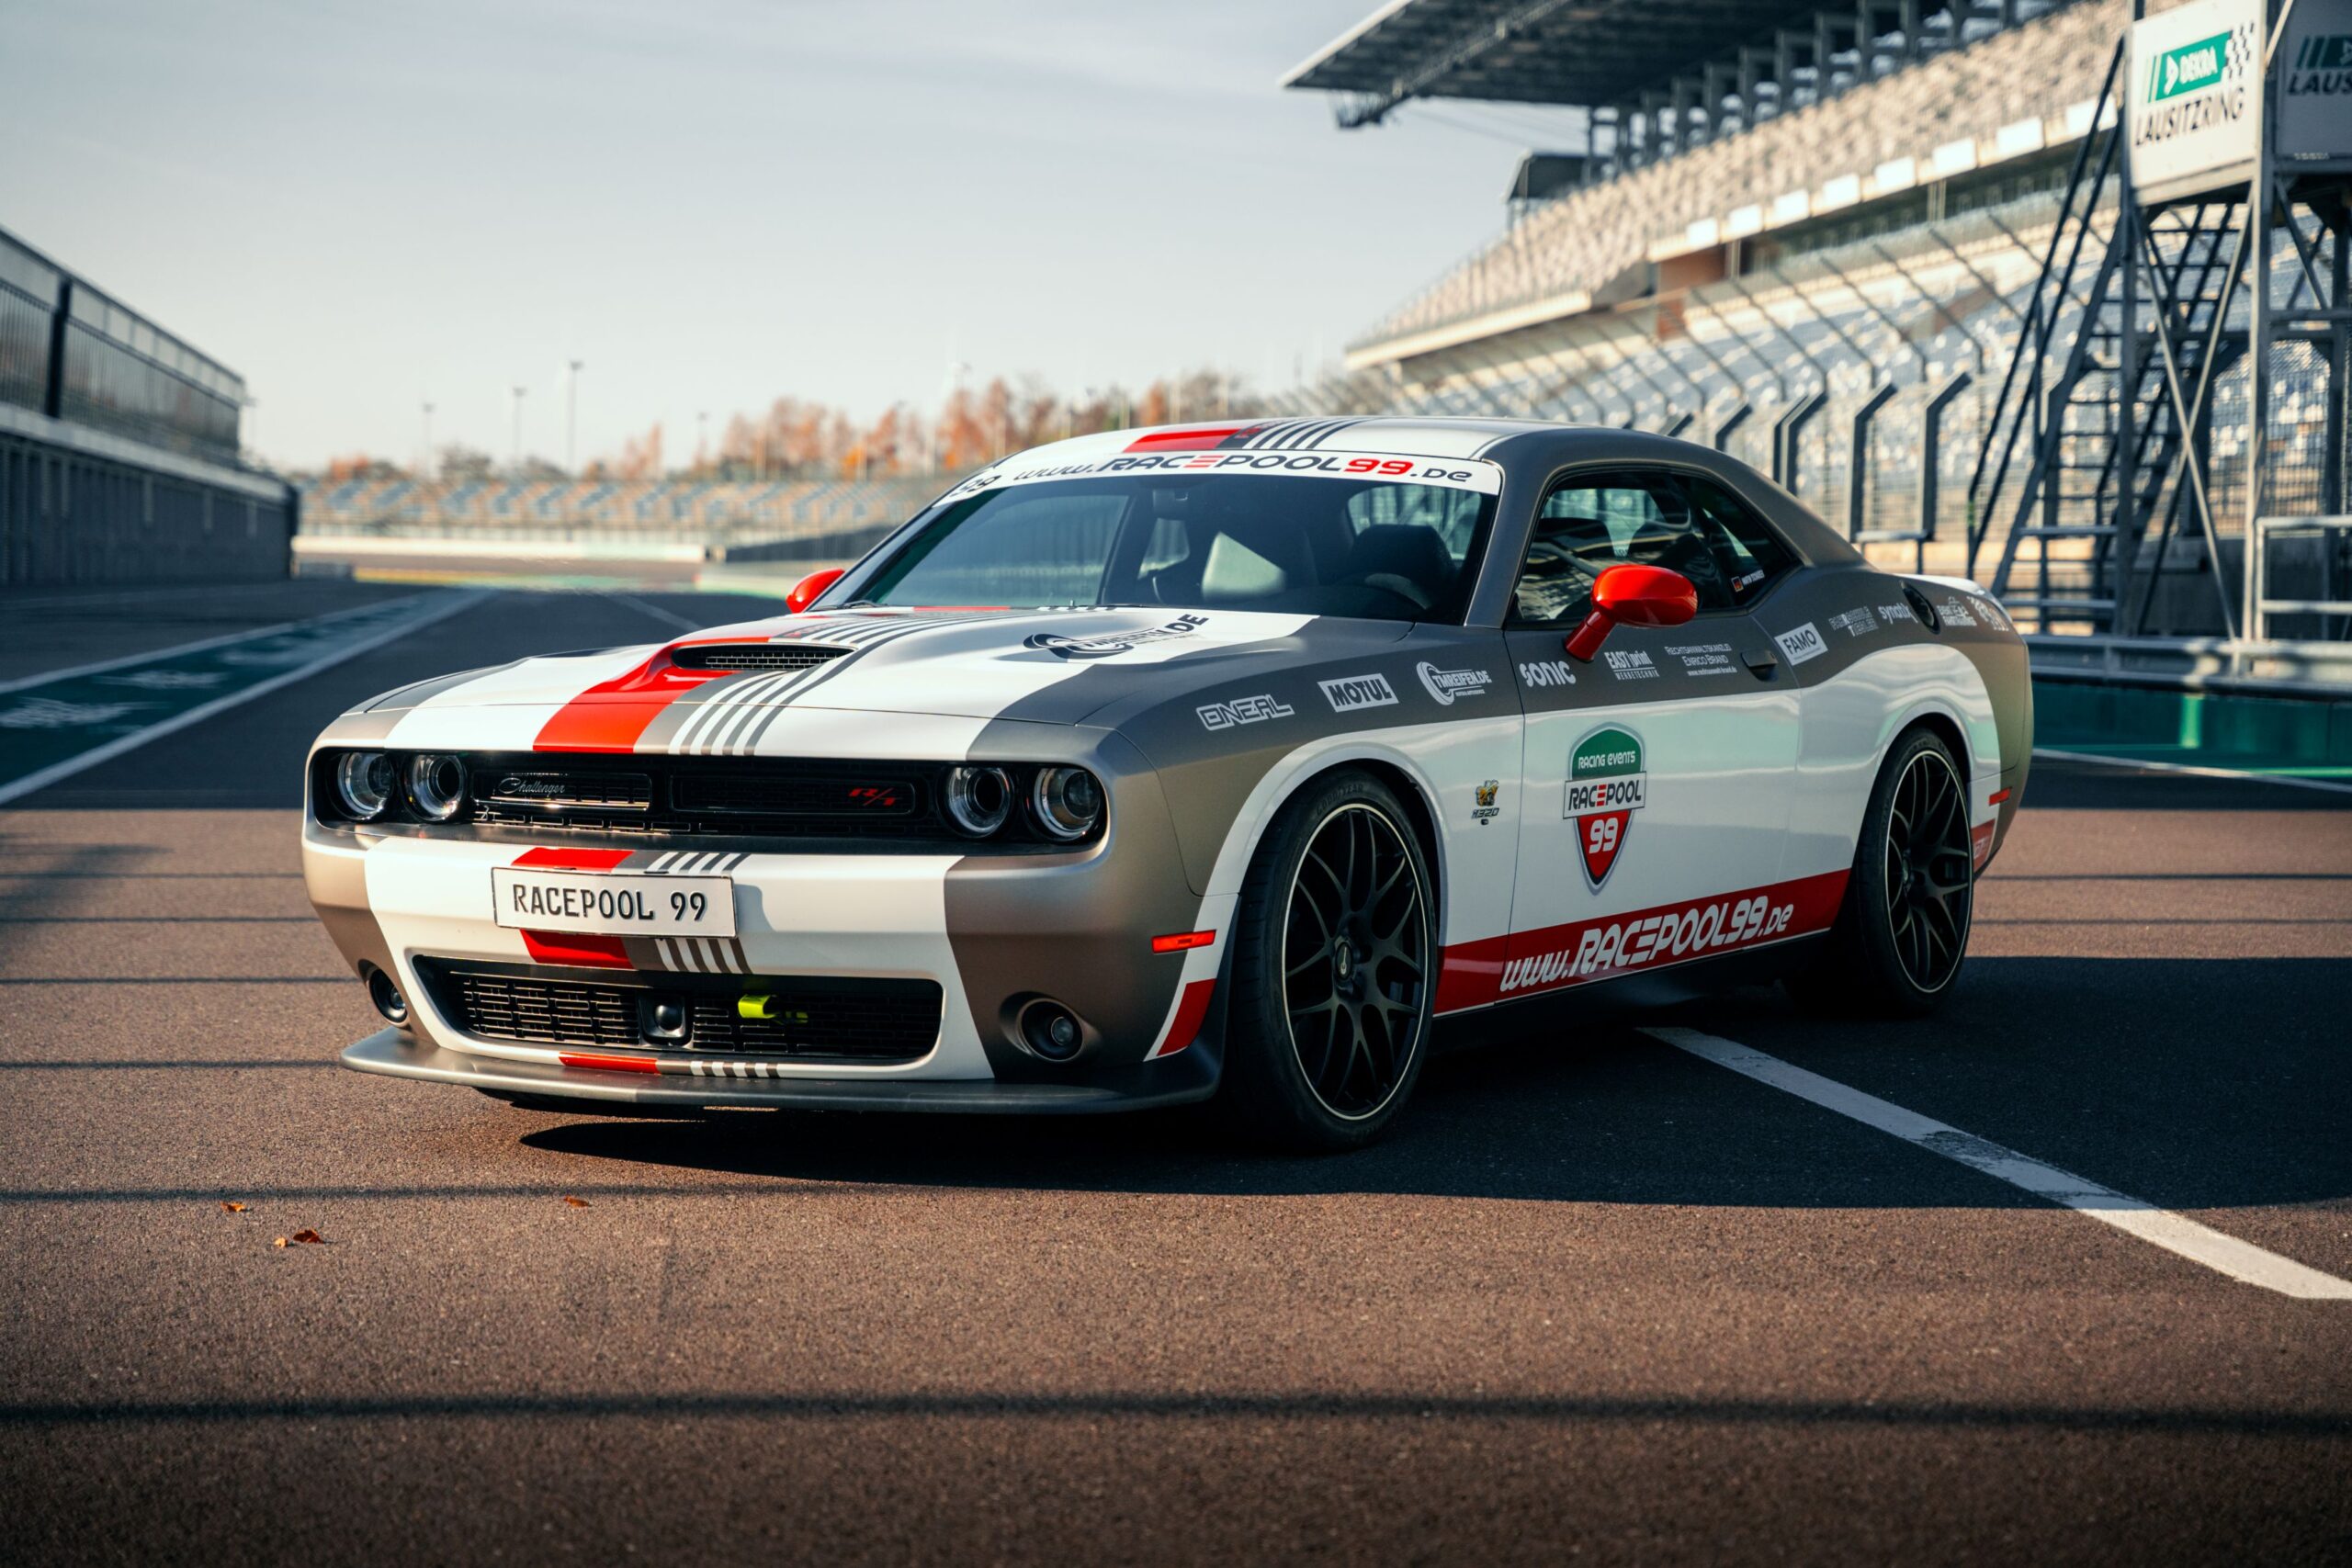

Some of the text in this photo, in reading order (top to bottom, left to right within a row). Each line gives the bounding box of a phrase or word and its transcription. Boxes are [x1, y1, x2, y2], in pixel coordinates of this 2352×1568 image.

[2135, 86, 2245, 147] LAUSITZRING
[1782, 629, 1817, 655] FAMO
[1519, 660, 1577, 688] SONIC
[1327, 679, 1392, 706] MOTUL
[499, 777, 565, 797] Challenger
[1568, 780, 1642, 811] RACEPOOL
[1589, 818, 1619, 854] 99
[513, 884, 707, 921] RACEPOOL 99
